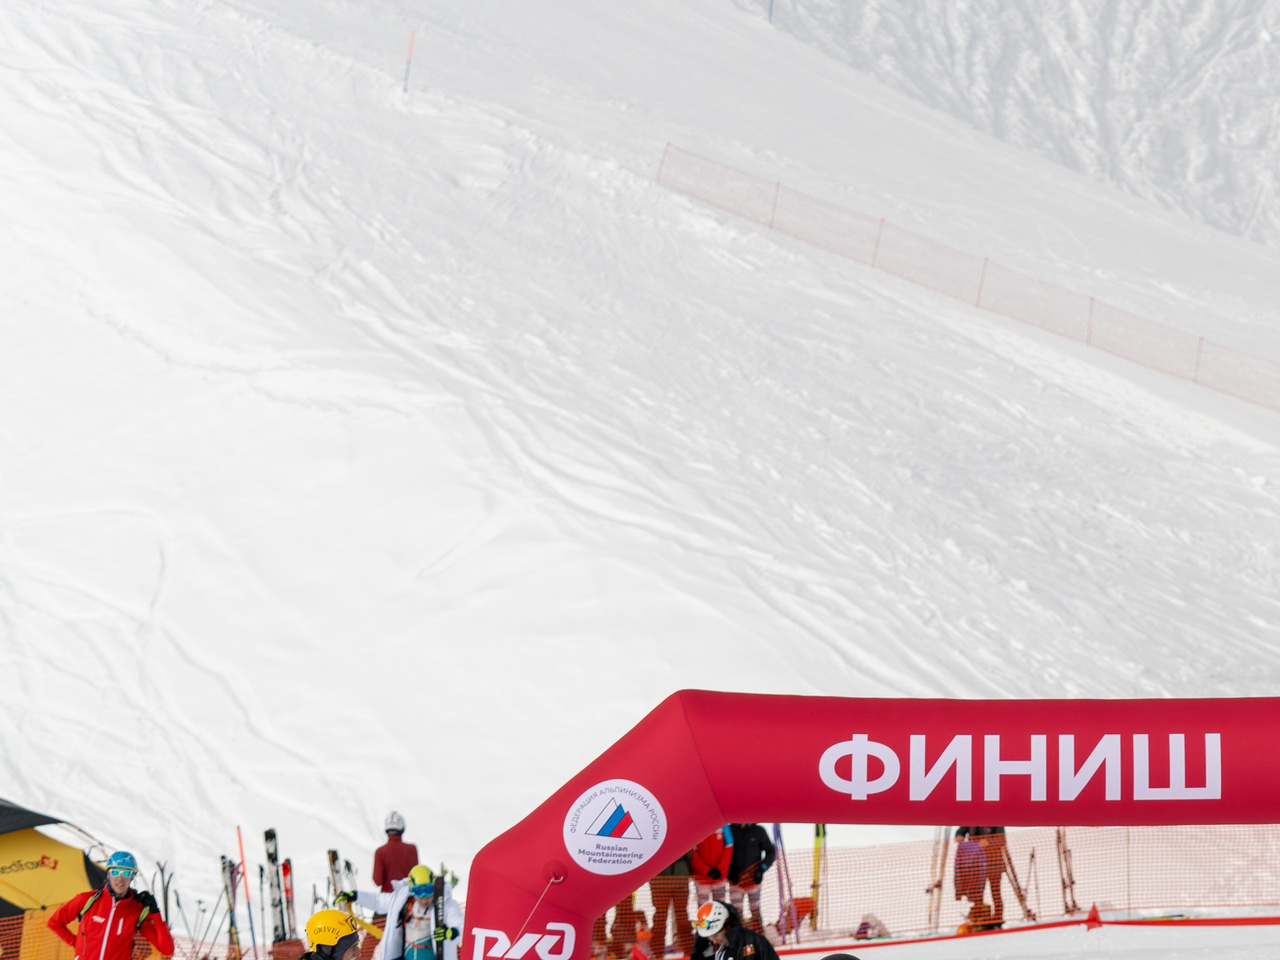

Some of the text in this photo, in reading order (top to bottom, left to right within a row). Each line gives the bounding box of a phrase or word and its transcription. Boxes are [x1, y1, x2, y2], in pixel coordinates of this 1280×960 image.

[818, 733, 1222, 801] ФИНИШ
[570, 786, 660, 841] ФЕДЕРАЦИЯ АЛЬПИНИЗМА РОССИИ
[595, 843, 628, 852] Russian
[578, 849, 644, 859] Mountaineering
[587, 857, 632, 865] Federation
[313, 926, 341, 937] GRIVEL
